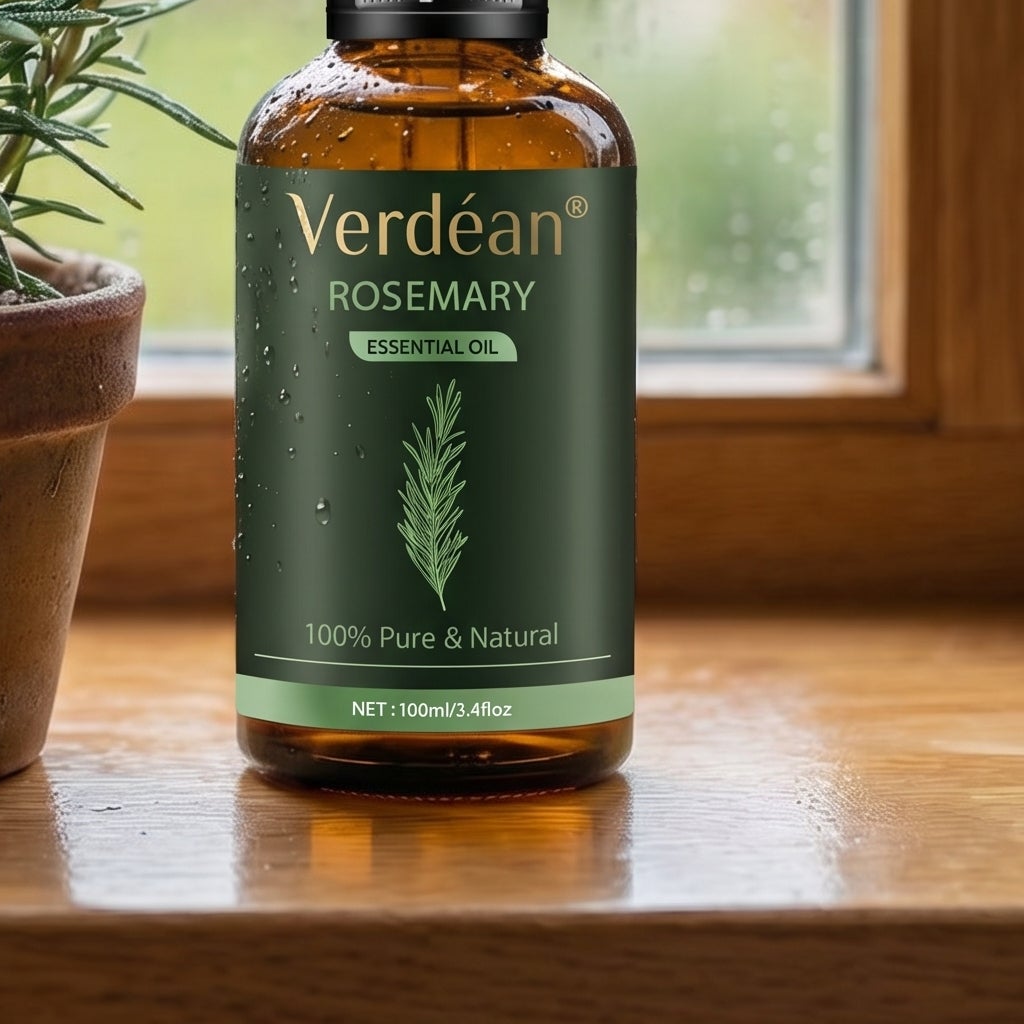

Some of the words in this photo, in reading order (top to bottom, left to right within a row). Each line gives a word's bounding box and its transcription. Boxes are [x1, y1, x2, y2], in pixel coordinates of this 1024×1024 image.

[329, 280, 536, 311] ROSEMARY
[367, 340, 464, 355] ESSENTIAL
[468, 340, 499, 355] OIL
[305, 622, 372, 649] 100%
[380, 626, 436, 650] Pure
[444, 626, 463, 650] &
[470, 622, 559, 649] Natural
